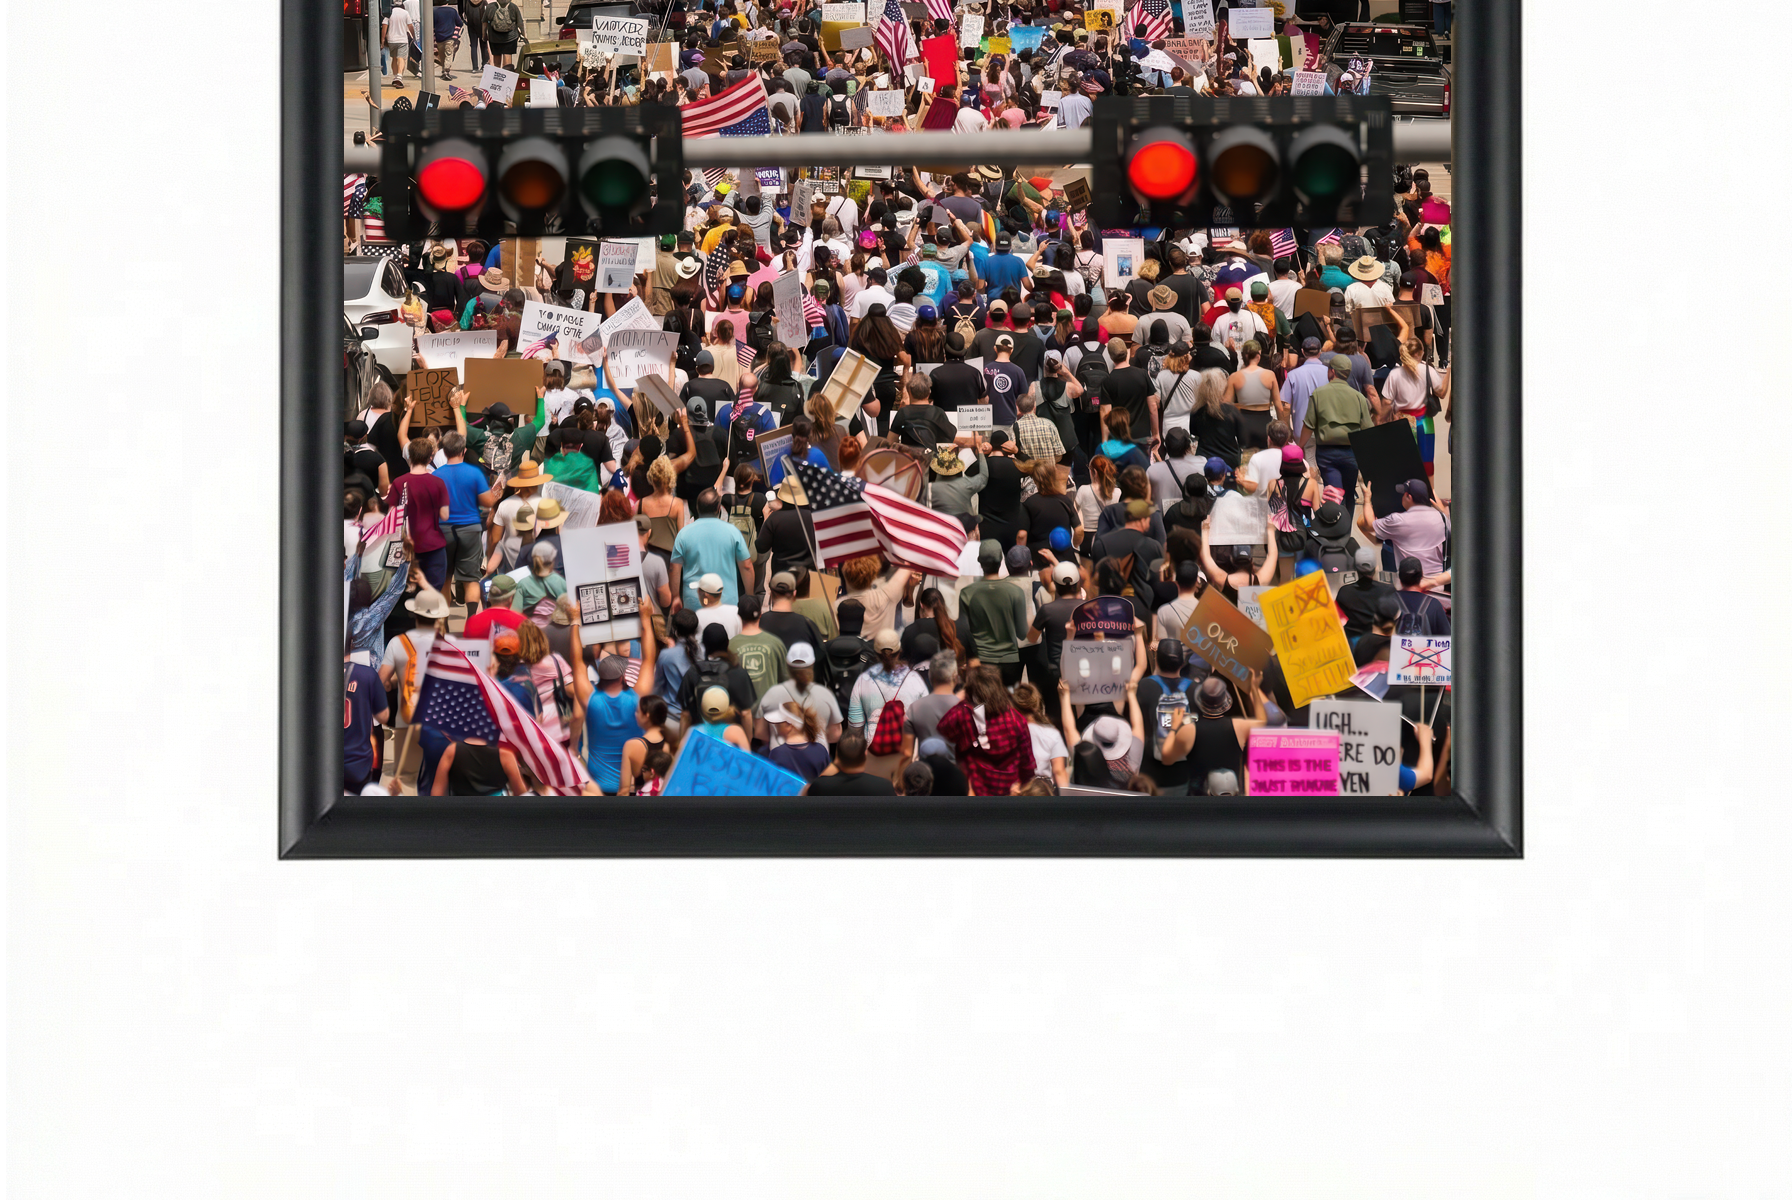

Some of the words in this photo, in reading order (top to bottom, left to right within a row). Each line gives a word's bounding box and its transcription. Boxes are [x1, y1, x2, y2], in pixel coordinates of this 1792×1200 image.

[1373, 745, 1396, 767] DO
[1253, 759, 1286, 772] THIS
[1288, 759, 1301, 772] IS
[1304, 759, 1332, 772] THE
